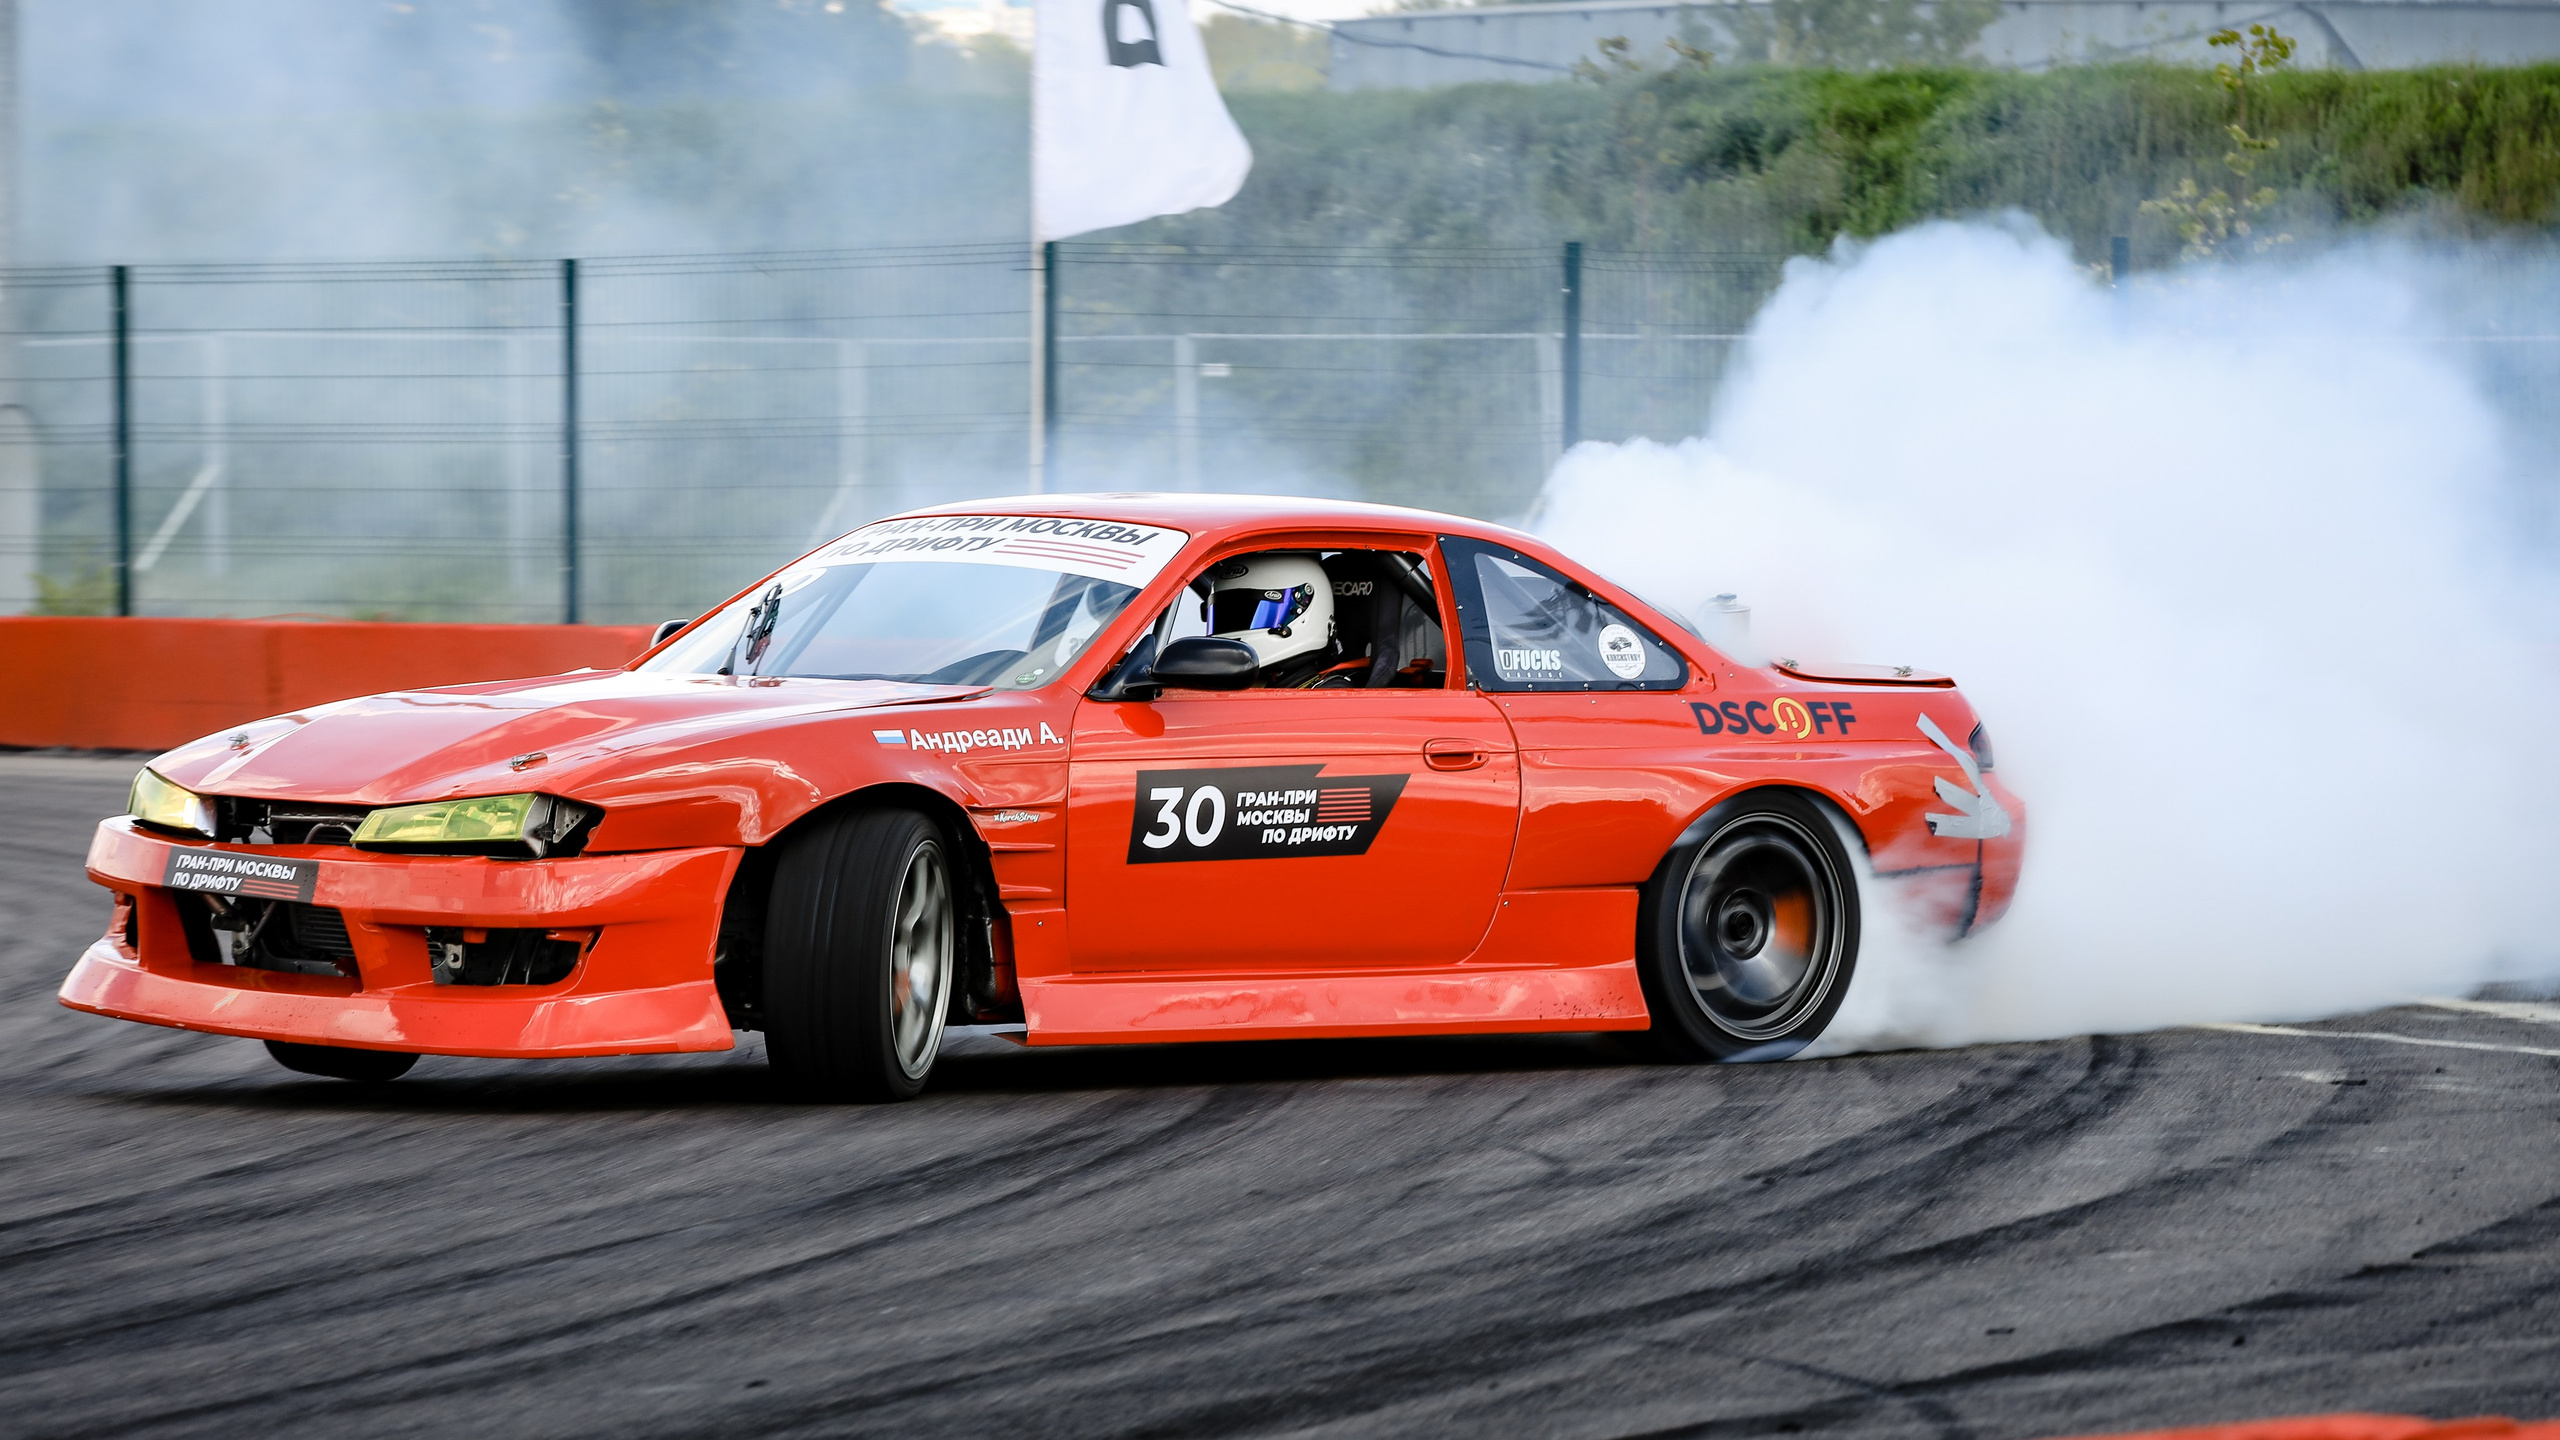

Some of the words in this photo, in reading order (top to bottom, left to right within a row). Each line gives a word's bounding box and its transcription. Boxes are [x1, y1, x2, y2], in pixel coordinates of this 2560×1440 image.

[847, 518, 1007, 541] ГРАН-ПРИ
[998, 518, 1160, 546] МОСКВЫ
[817, 541, 870, 560] ПО
[858, 536, 1007, 556] ДРИФТУ
[1332, 581, 1373, 596] ECARO
[909, 727, 1034, 753] Андреади
[1039, 721, 1064, 745] А.
[1236, 789, 1317, 808] ГРАН-ПРИ
[1142, 785, 1226, 849] 30
[1236, 808, 1310, 826] МОСКВЫ
[1261, 828, 1283, 844] ПО
[1287, 824, 1358, 845] ДРИФТУ
[175, 854, 233, 873] ГРАН-ПРИ
[234, 860, 297, 881] МОСКВЫ
[171, 872, 190, 886] ПО
[188, 873, 243, 891] ДРИФТУ
